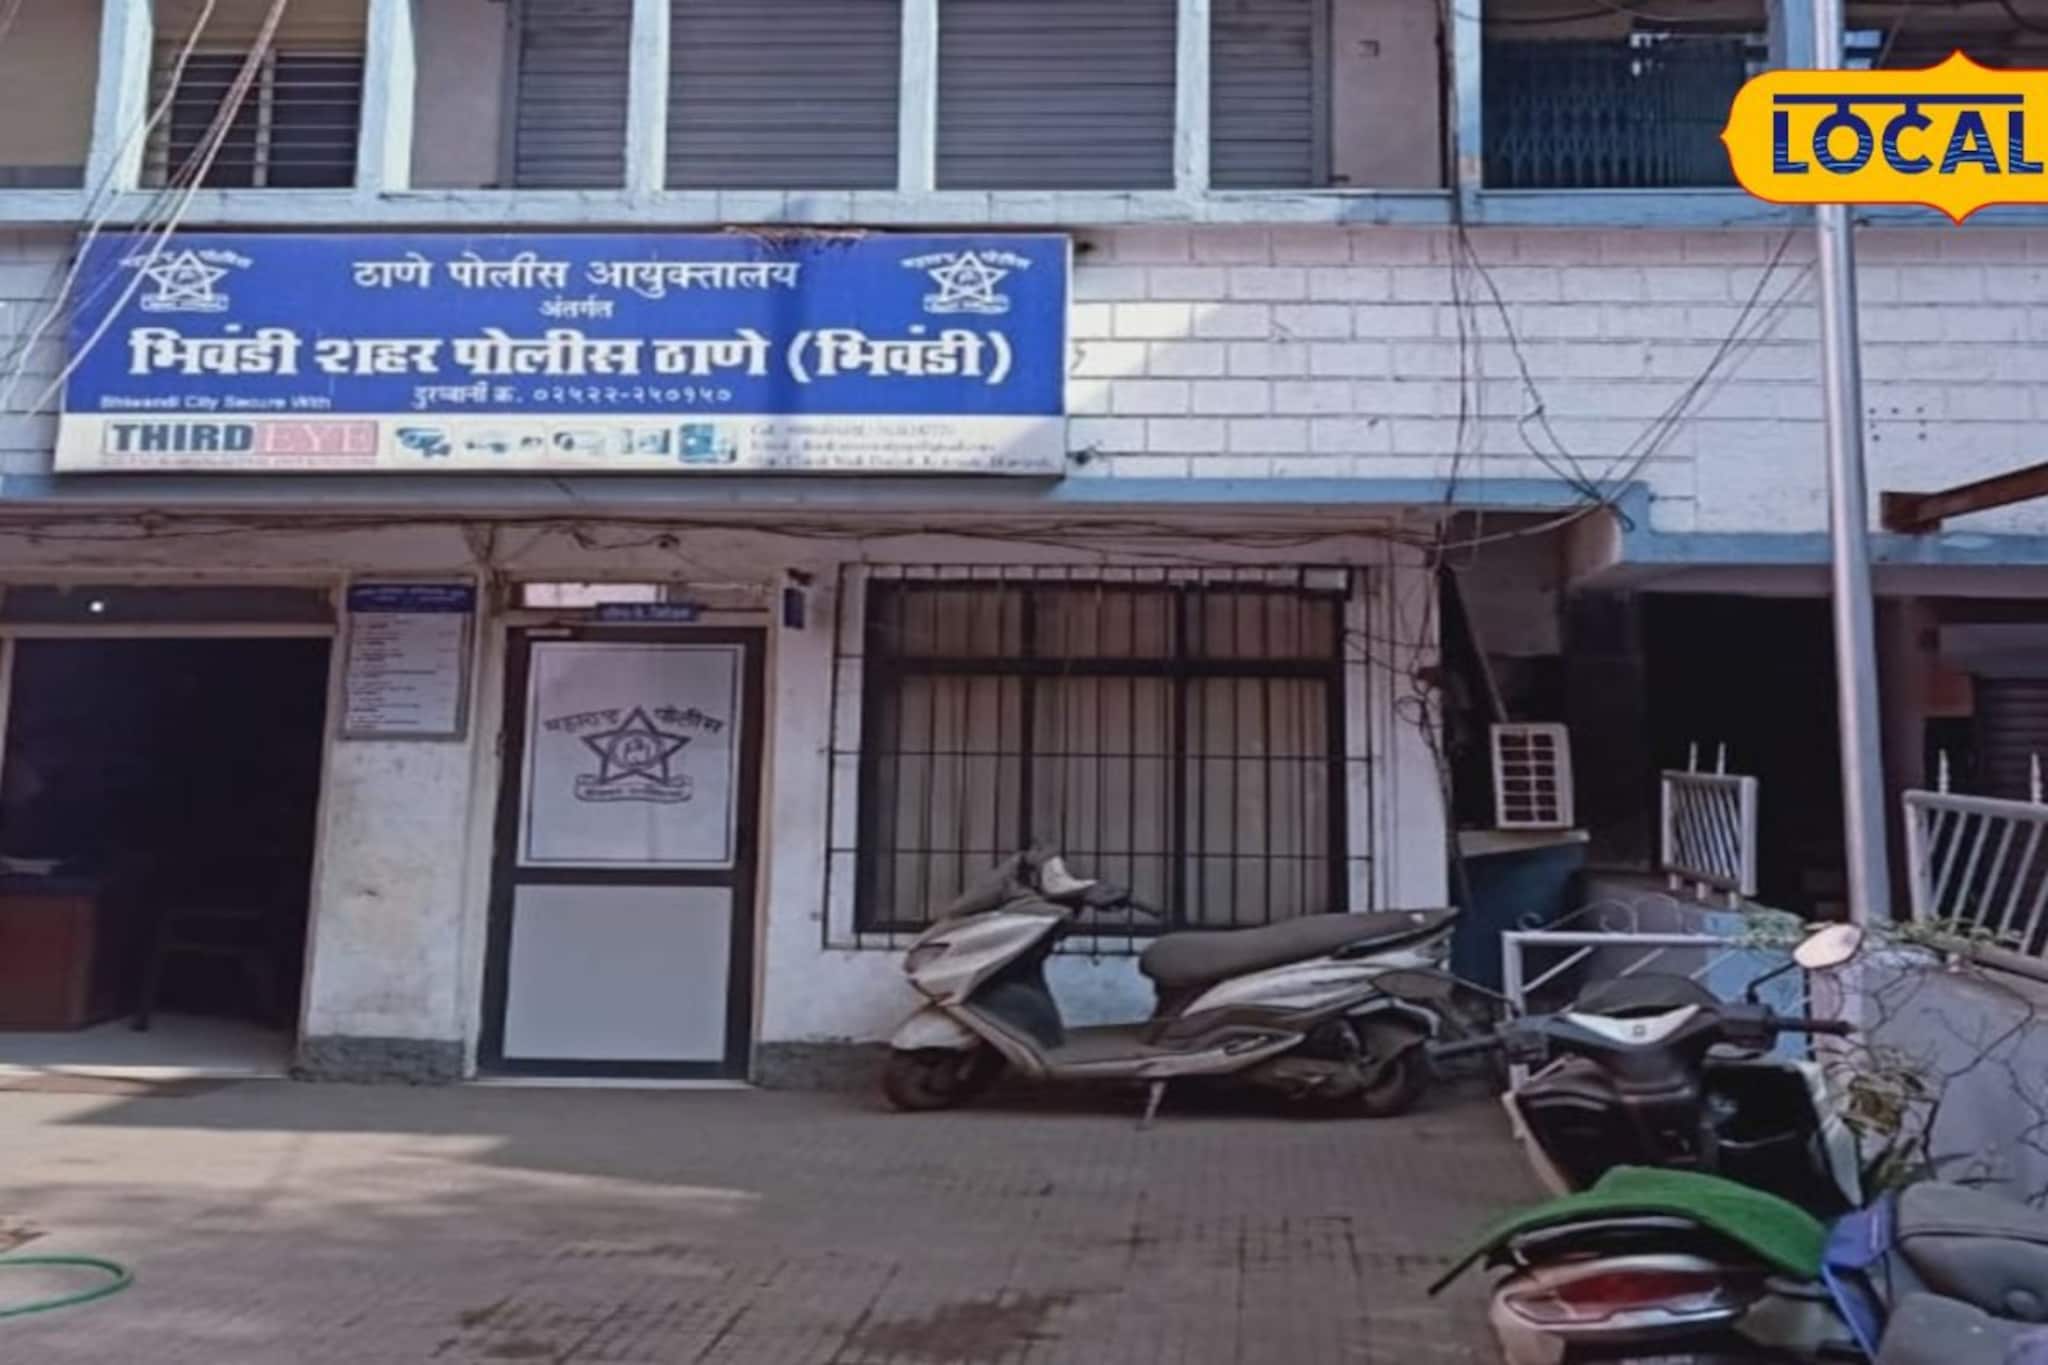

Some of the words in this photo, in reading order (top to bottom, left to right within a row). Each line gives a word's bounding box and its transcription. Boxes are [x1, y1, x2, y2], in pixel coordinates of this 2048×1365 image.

[353, 252, 433, 288] ठाणे
[447, 251, 570, 289] पोलीस
[585, 259, 800, 298] आयुक्तालय
[538, 295, 613, 319] अंतर्गत
[128, 323, 302, 376] भिवंडी
[314, 336, 442, 376] शहर
[452, 328, 643, 376] पोलीस
[652, 328, 772, 377] ठाणे
[787, 324, 1013, 385] (भिवंडी)
[112, 423, 254, 451] THIRD
[264, 422, 373, 454] EYE
